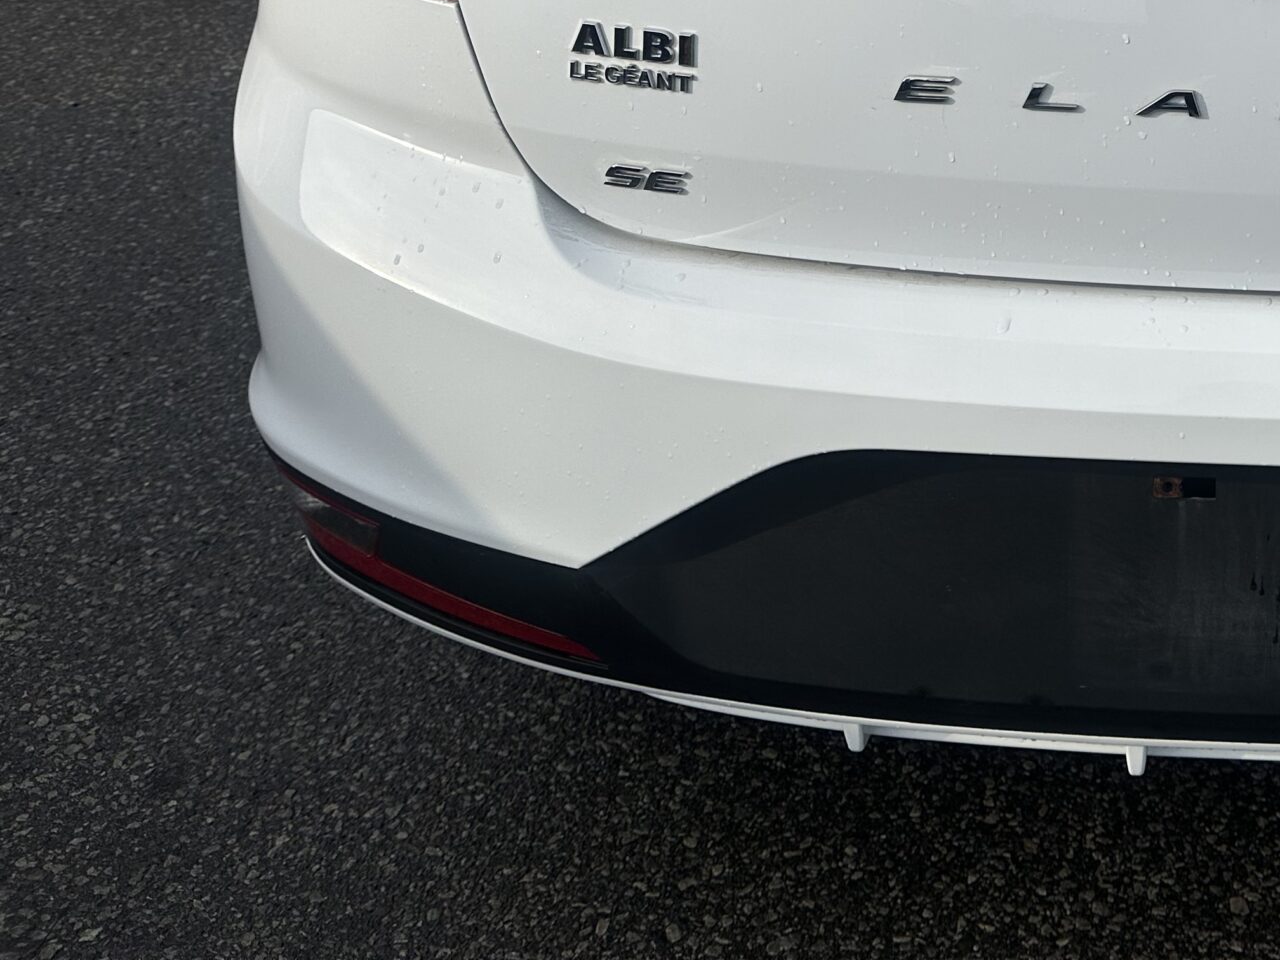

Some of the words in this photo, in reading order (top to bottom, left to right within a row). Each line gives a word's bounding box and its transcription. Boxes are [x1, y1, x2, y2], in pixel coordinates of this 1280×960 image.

[571, 20, 699, 68] ALBI
[569, 60, 604, 83] LE
[605, 63, 698, 94] GÉANT
[604, 163, 693, 196] SE
